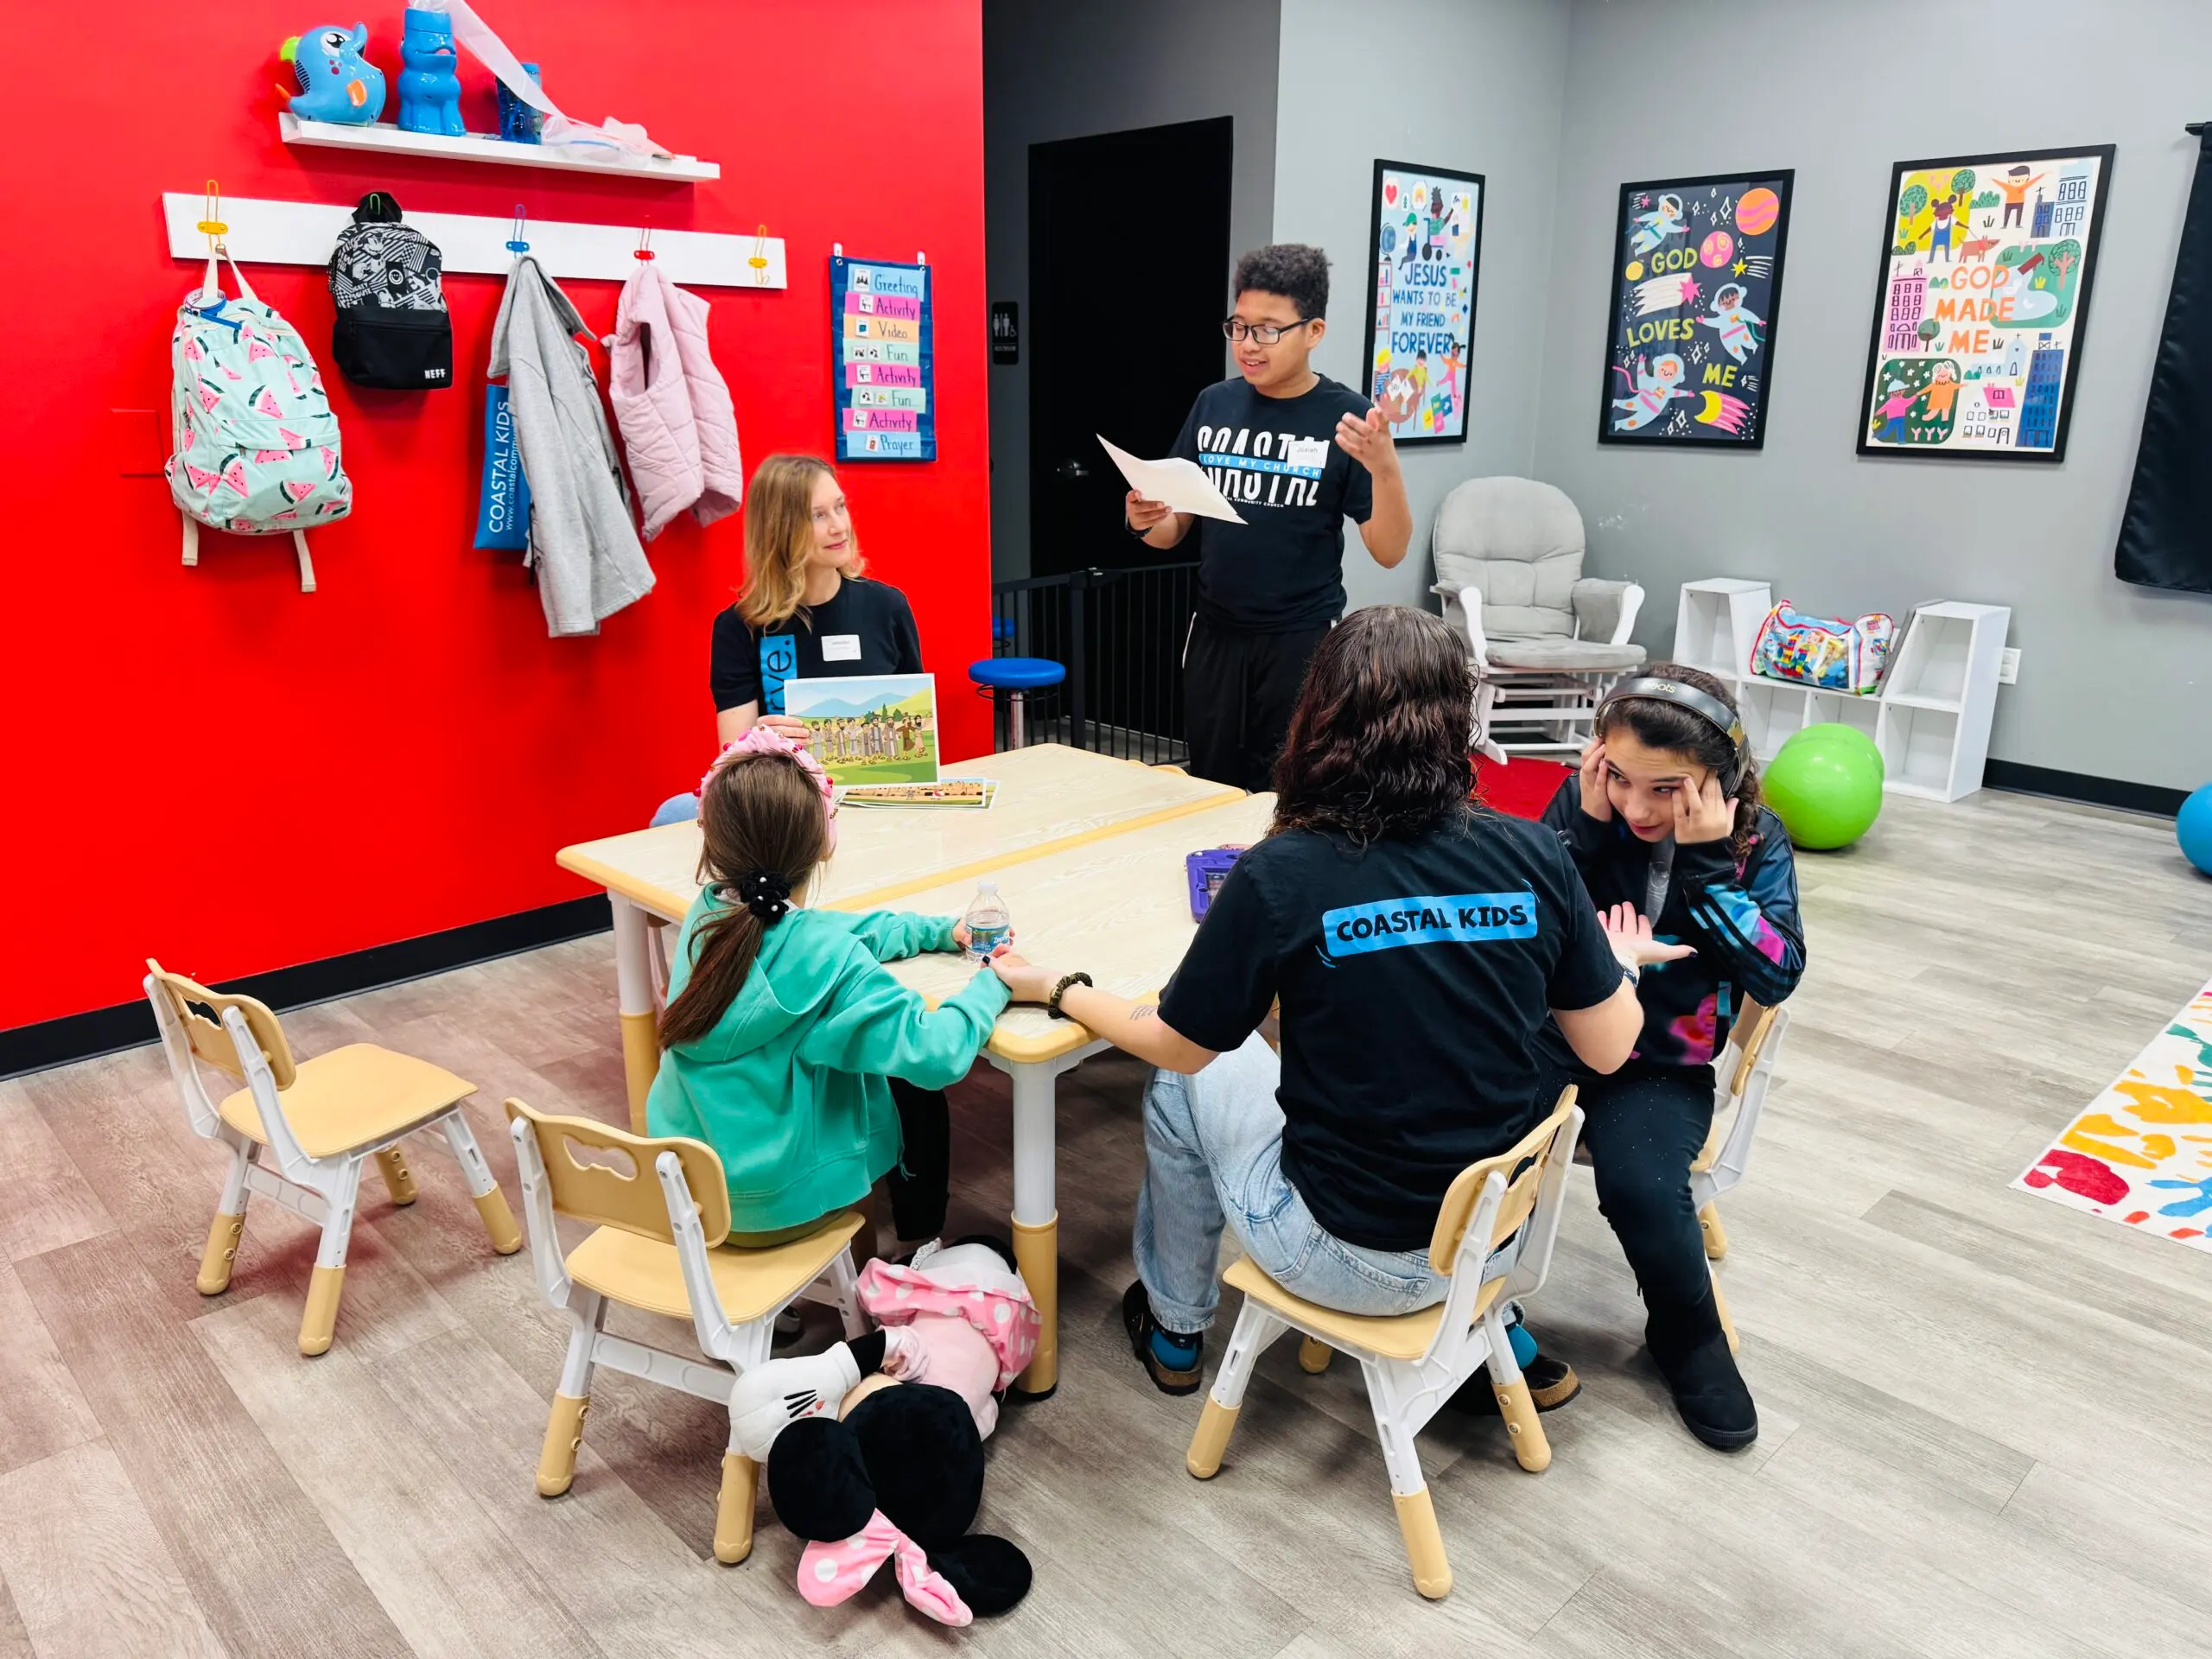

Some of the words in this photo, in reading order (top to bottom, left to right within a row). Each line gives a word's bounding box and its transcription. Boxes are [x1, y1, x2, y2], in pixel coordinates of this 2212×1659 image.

[1651, 248, 1698, 274] GOD
[874, 274, 918, 297] Greeting
[1405, 263, 1447, 287] JESUS
[1950, 265, 2009, 290] GOD
[1393, 289, 1424, 305] WANTS
[1427, 291, 1441, 306] TO
[1445, 292, 1457, 307] BE
[1934, 297, 2015, 321] MADE
[876, 300, 916, 321] Activity
[1400, 311, 1414, 327] MY
[1416, 311, 1446, 327] FRIEND
[878, 321, 908, 339] Video
[1626, 318, 1695, 347] LOVES
[1948, 329, 1990, 353] ME
[887, 344, 908, 360] Fun
[1392, 331, 1451, 354] FOREVER
[424, 368, 446, 379] NEFF
[876, 366, 916, 387] Activity
[1702, 363, 1738, 387] ME
[892, 391, 912, 406] Fun
[496, 401, 511, 444] KIDS
[869, 412, 912, 430] Activity
[880, 435, 914, 451] Prayer
[1204, 455, 1230, 466] LOVE
[1238, 458, 1258, 467] MY
[1263, 461, 1319, 477] CHURCH
[489, 448, 509, 533] COASTAL
[1337, 907, 1452, 942] COASTAL
[1459, 905, 1529, 929] KIDS
